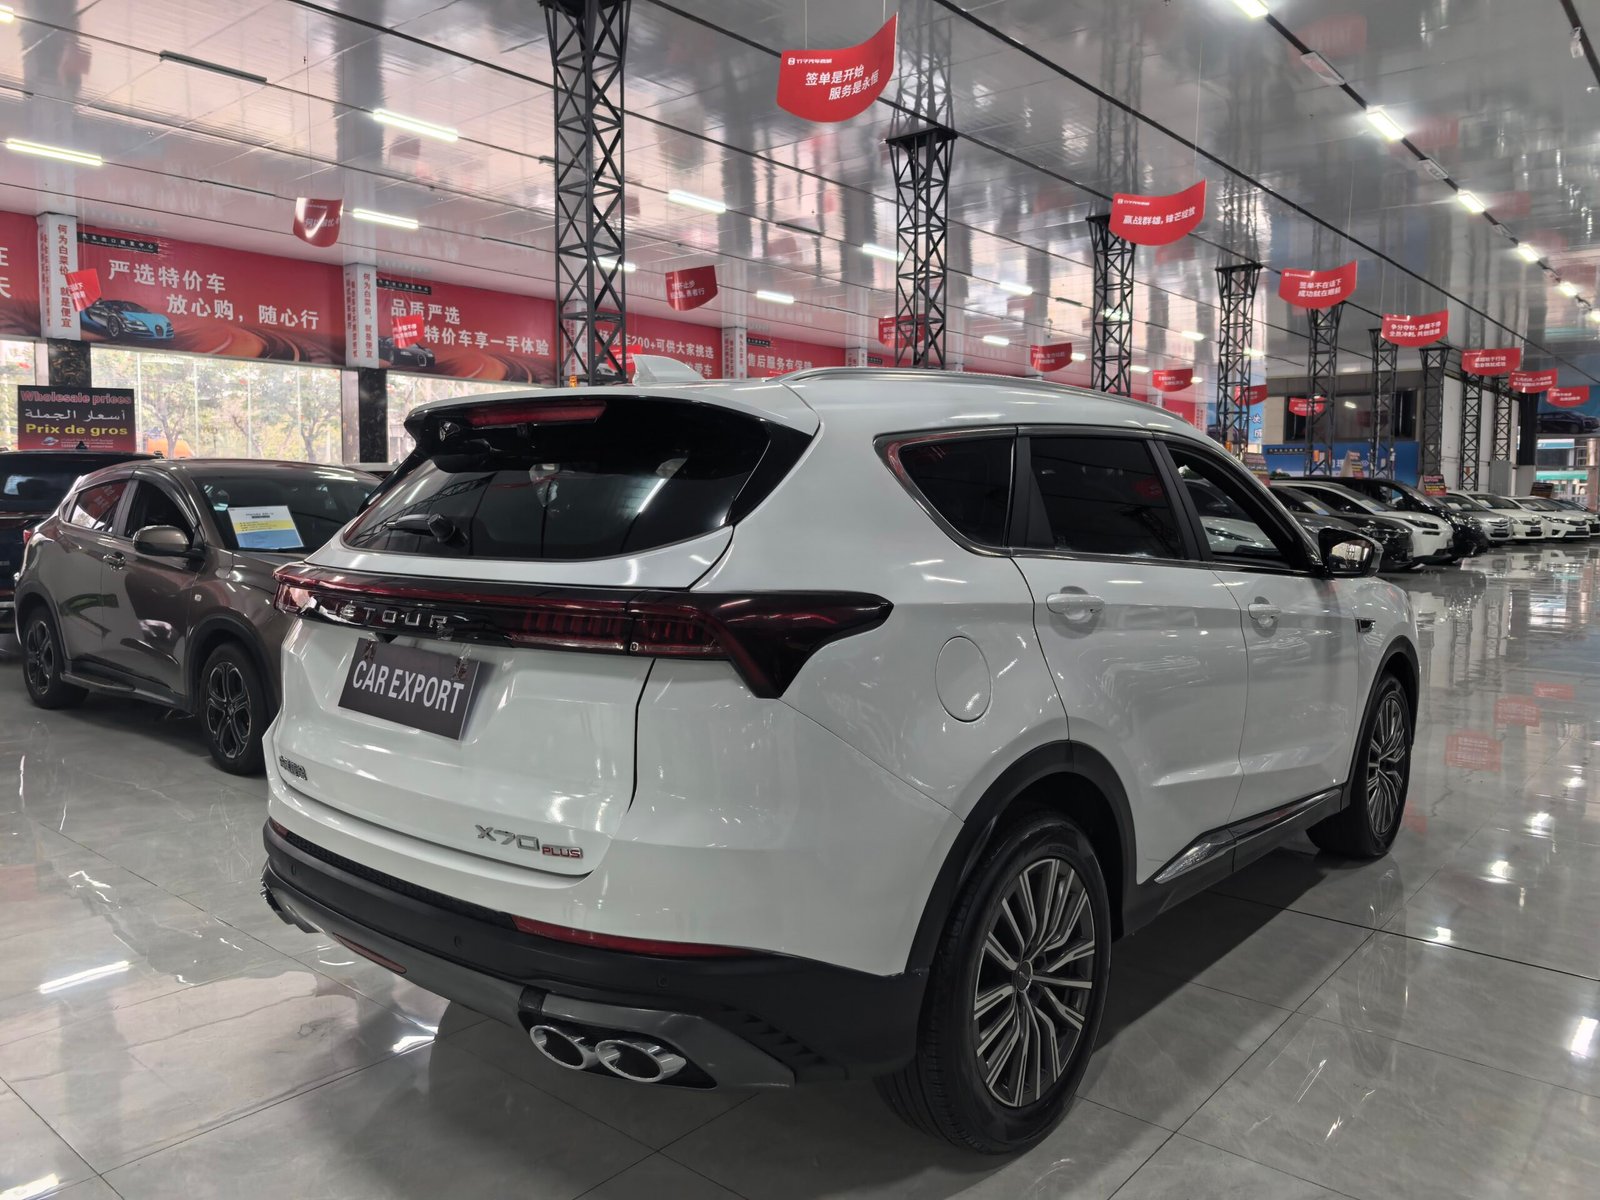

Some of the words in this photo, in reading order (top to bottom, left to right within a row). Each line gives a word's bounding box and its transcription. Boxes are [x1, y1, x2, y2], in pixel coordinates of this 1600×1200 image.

[805, 64, 864, 86] 签单是开始
[828, 69, 879, 100] 服务是永恒
[108, 259, 226, 294] 严选特价车
[167, 294, 320, 330] 放心购，随心行
[391, 298, 460, 325] 品质严选
[424, 325, 550, 356] 特价车享一手体验
[21, 390, 90, 404] Wholesale
[92, 393, 131, 405] prices
[25, 408, 77, 421] الجملة
[84, 409, 126, 422] أسعار
[25, 423, 60, 434] Prix
[64, 424, 85, 434] de
[90, 427, 128, 436] gros
[352, 660, 389, 695] CAR
[389, 668, 464, 713] EXPORT
[475, 824, 540, 852] X70
[542, 844, 583, 859] PLUS
